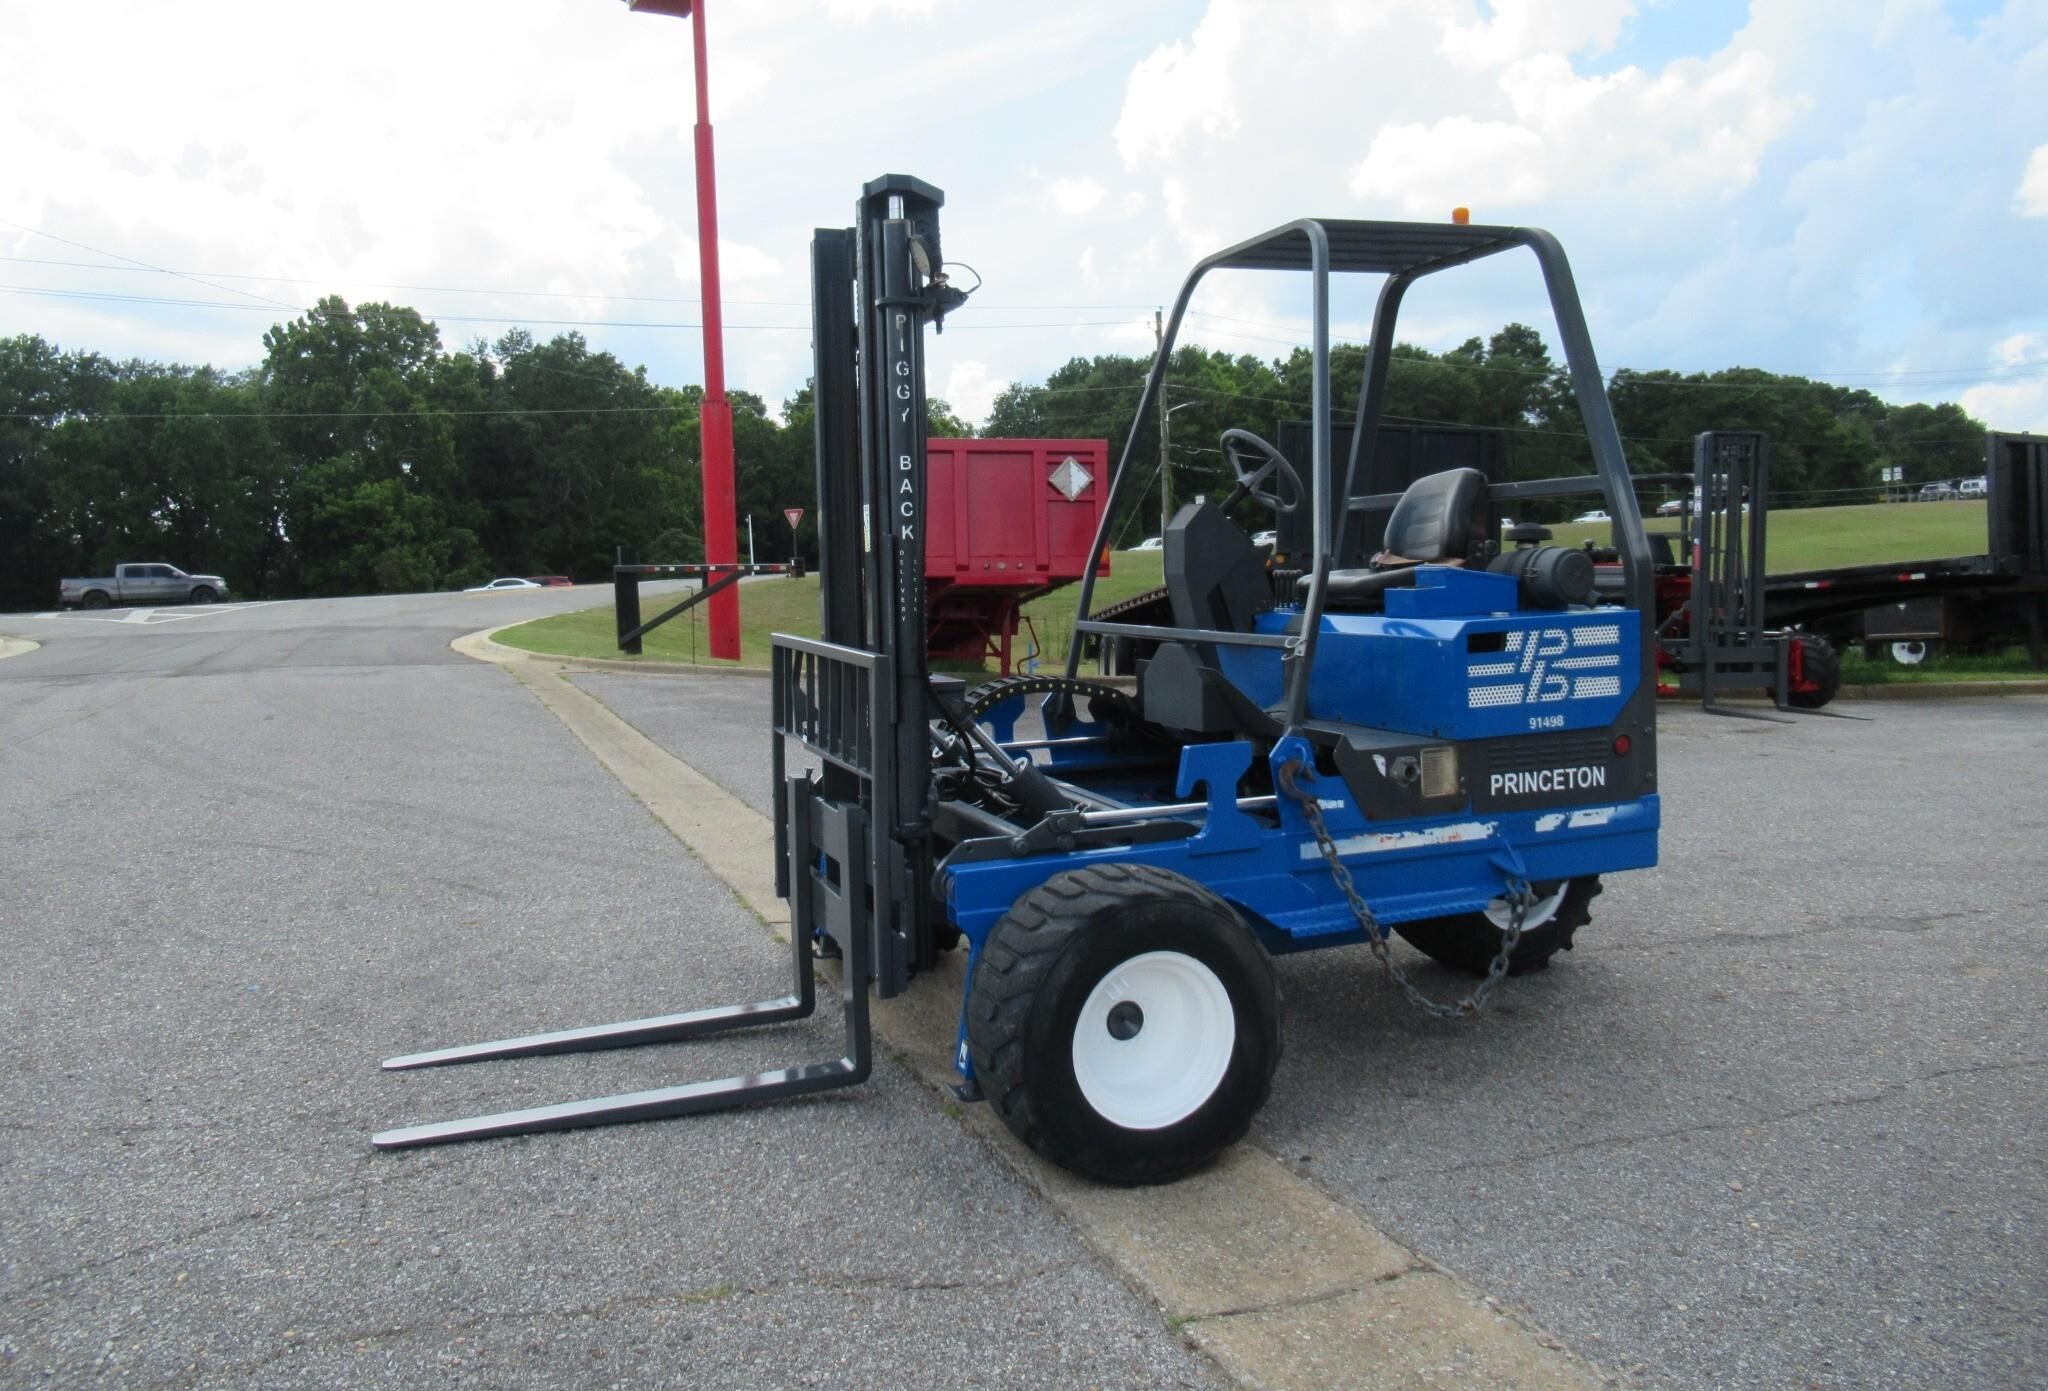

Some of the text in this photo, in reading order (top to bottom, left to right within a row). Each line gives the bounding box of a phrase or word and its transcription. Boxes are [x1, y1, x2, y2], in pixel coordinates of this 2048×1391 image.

[895, 314, 914, 540] PIGGY BACK
[1528, 714, 1565, 730] 91498
[1490, 765, 1606, 797] PRINCETON
